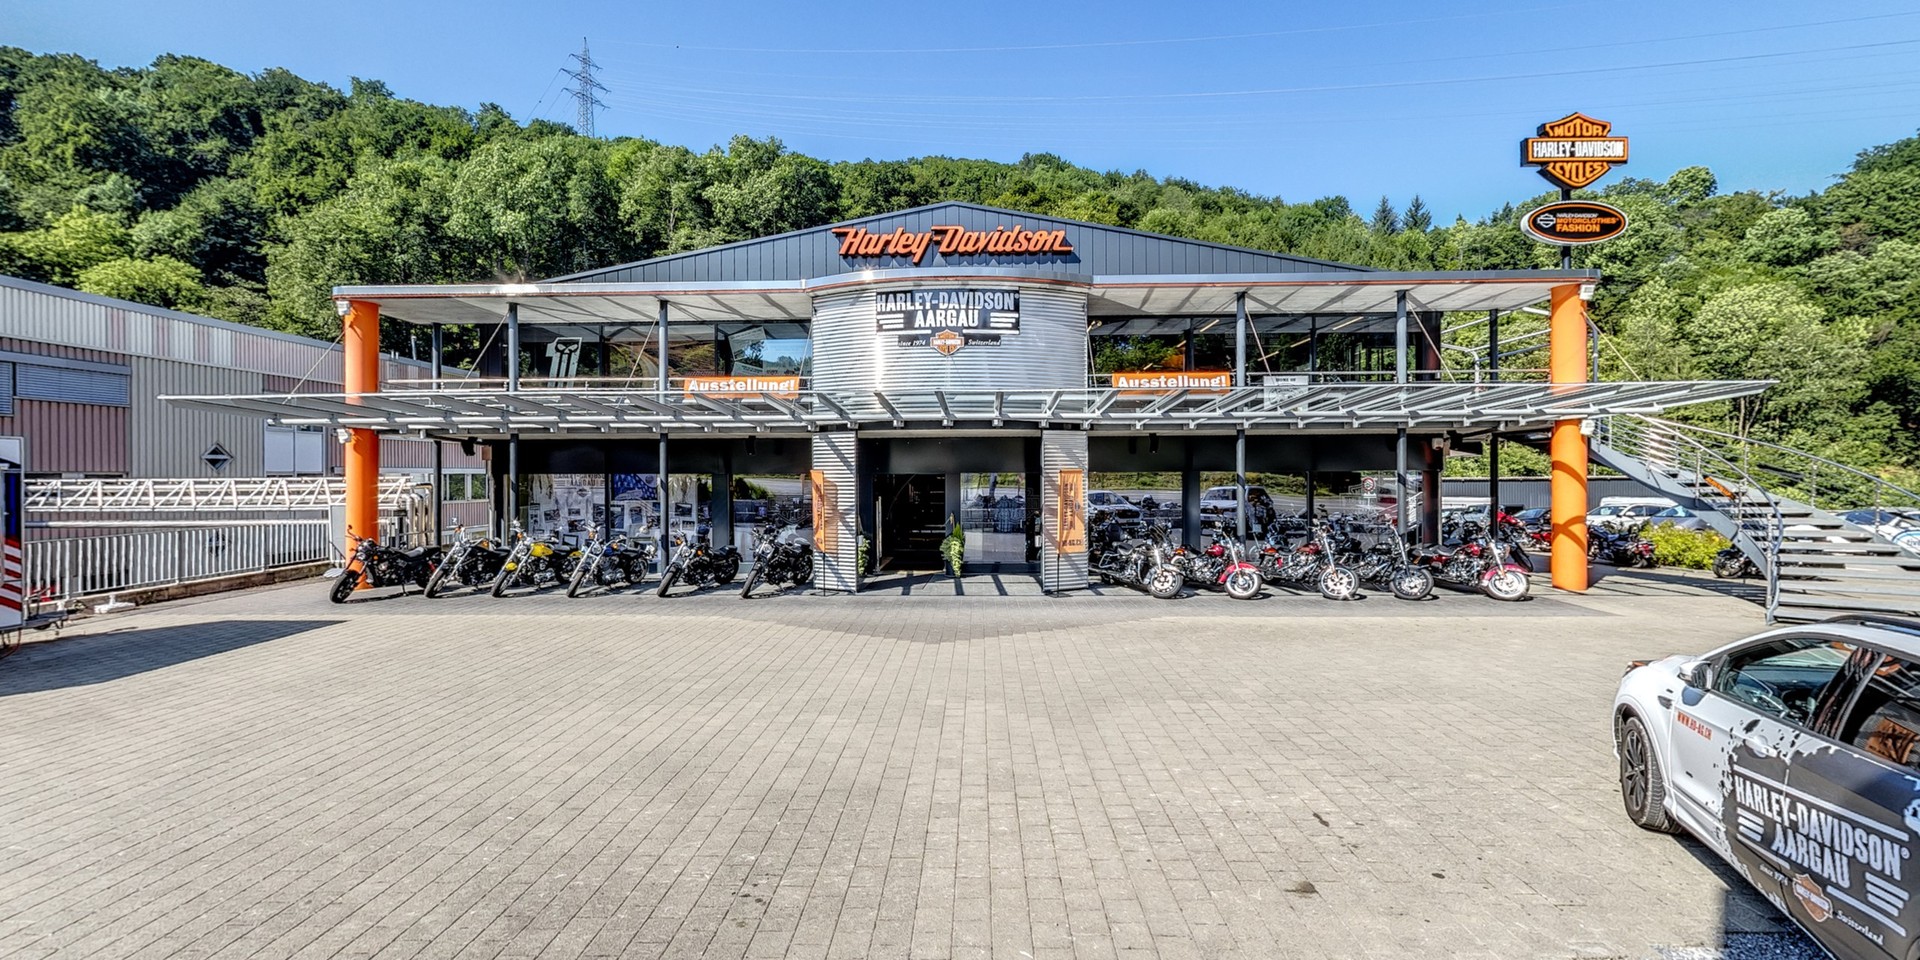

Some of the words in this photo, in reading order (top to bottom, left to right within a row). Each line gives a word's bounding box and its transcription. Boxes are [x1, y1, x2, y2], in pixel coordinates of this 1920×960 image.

[1553, 119, 1603, 137] MOTOR
[1533, 141, 1625, 158] HARLEY-DAVIDSON
[1555, 162, 1602, 182] CYCLES
[1556, 224, 1600, 232] FASHION
[832, 224, 1074, 264] Harley-Davidson
[914, 309, 979, 328] AARGAU
[688, 379, 795, 394] Ausstellung!
[1118, 375, 1227, 391] Ausstellung!
[1771, 823, 1850, 889] AARGAU
